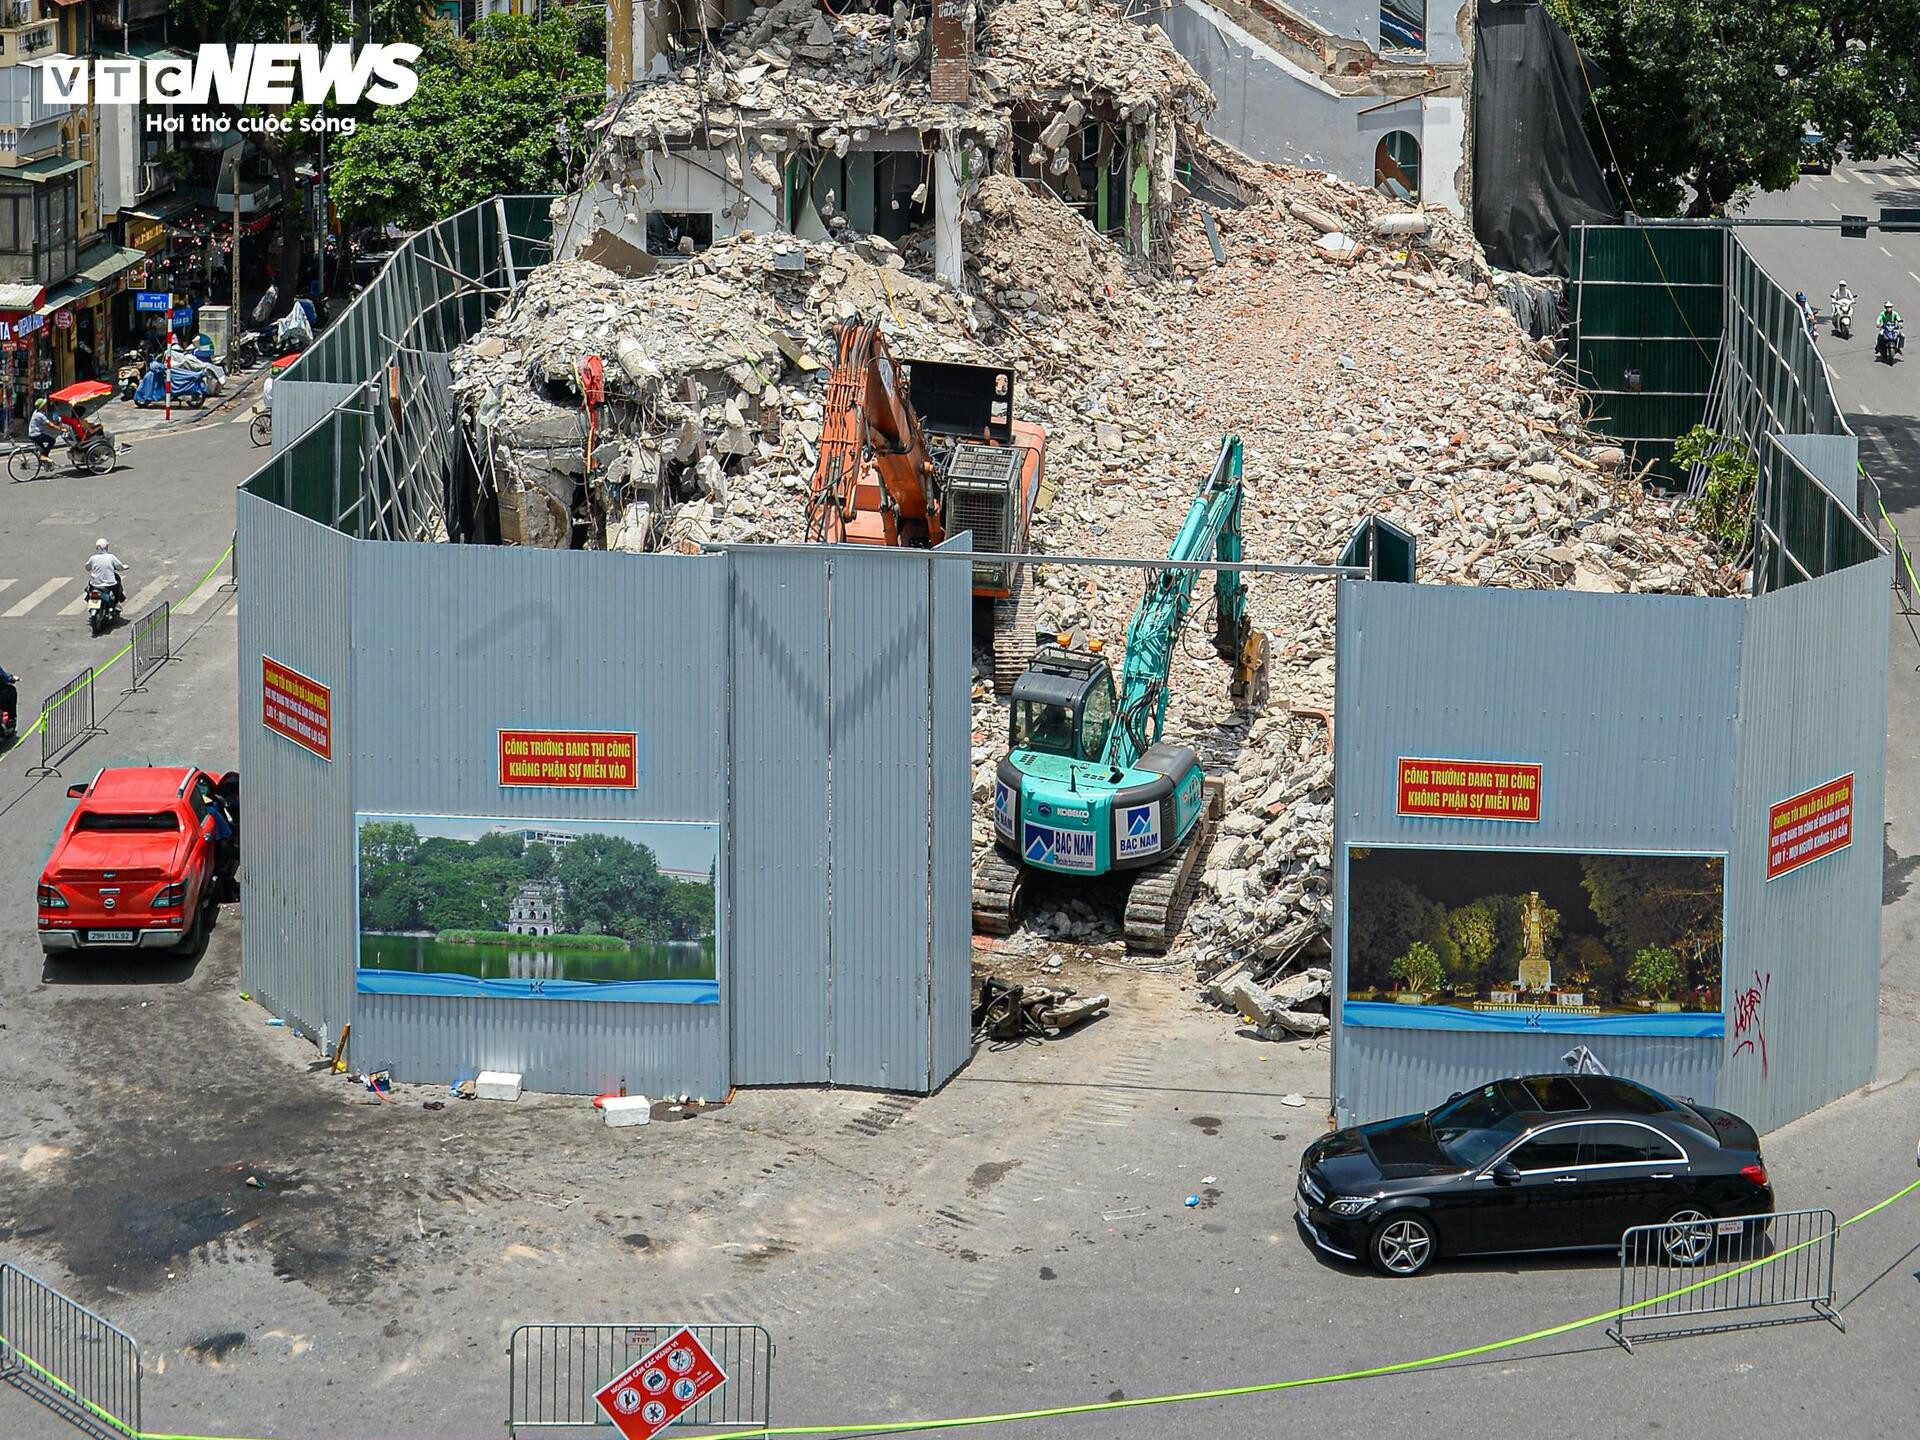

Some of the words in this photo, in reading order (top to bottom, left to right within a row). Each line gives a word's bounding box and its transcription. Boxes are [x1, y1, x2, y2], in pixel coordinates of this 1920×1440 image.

[505, 738, 529, 756] CÔNG
[530, 738, 564, 757] TRƯỜNG
[566, 742, 590, 757] ĐANG
[591, 742, 605, 757] THI
[606, 740, 631, 758] CÔNG
[509, 760, 541, 777] KHÔNG
[542, 760, 567, 780] PHẬN
[568, 762, 582, 781] SỰ
[583, 759, 607, 778] MIỄN
[608, 761, 626, 779] VÀO
[1404, 767, 1429, 785] CÔNG
[1430, 768, 1466, 786] TRƯỜNG
[1468, 771, 1493, 788] ĐANG
[1494, 773, 1509, 788] THI
[1510, 771, 1536, 790] CÔNG
[1408, 789, 1440, 807] KHÔNG
[1442, 790, 1468, 811] PHẬN
[1469, 793, 1485, 812] SỰ
[1485, 790, 1509, 811] MIỄN
[1511, 793, 1530, 811] VÀO
[1056, 808, 1089, 818] KOBELCO
[1055, 832, 1072, 855] BAC
[1074, 834, 1093, 856] NAM
[1120, 838, 1137, 851] BAC
[1140, 833, 1158, 848] NAM
